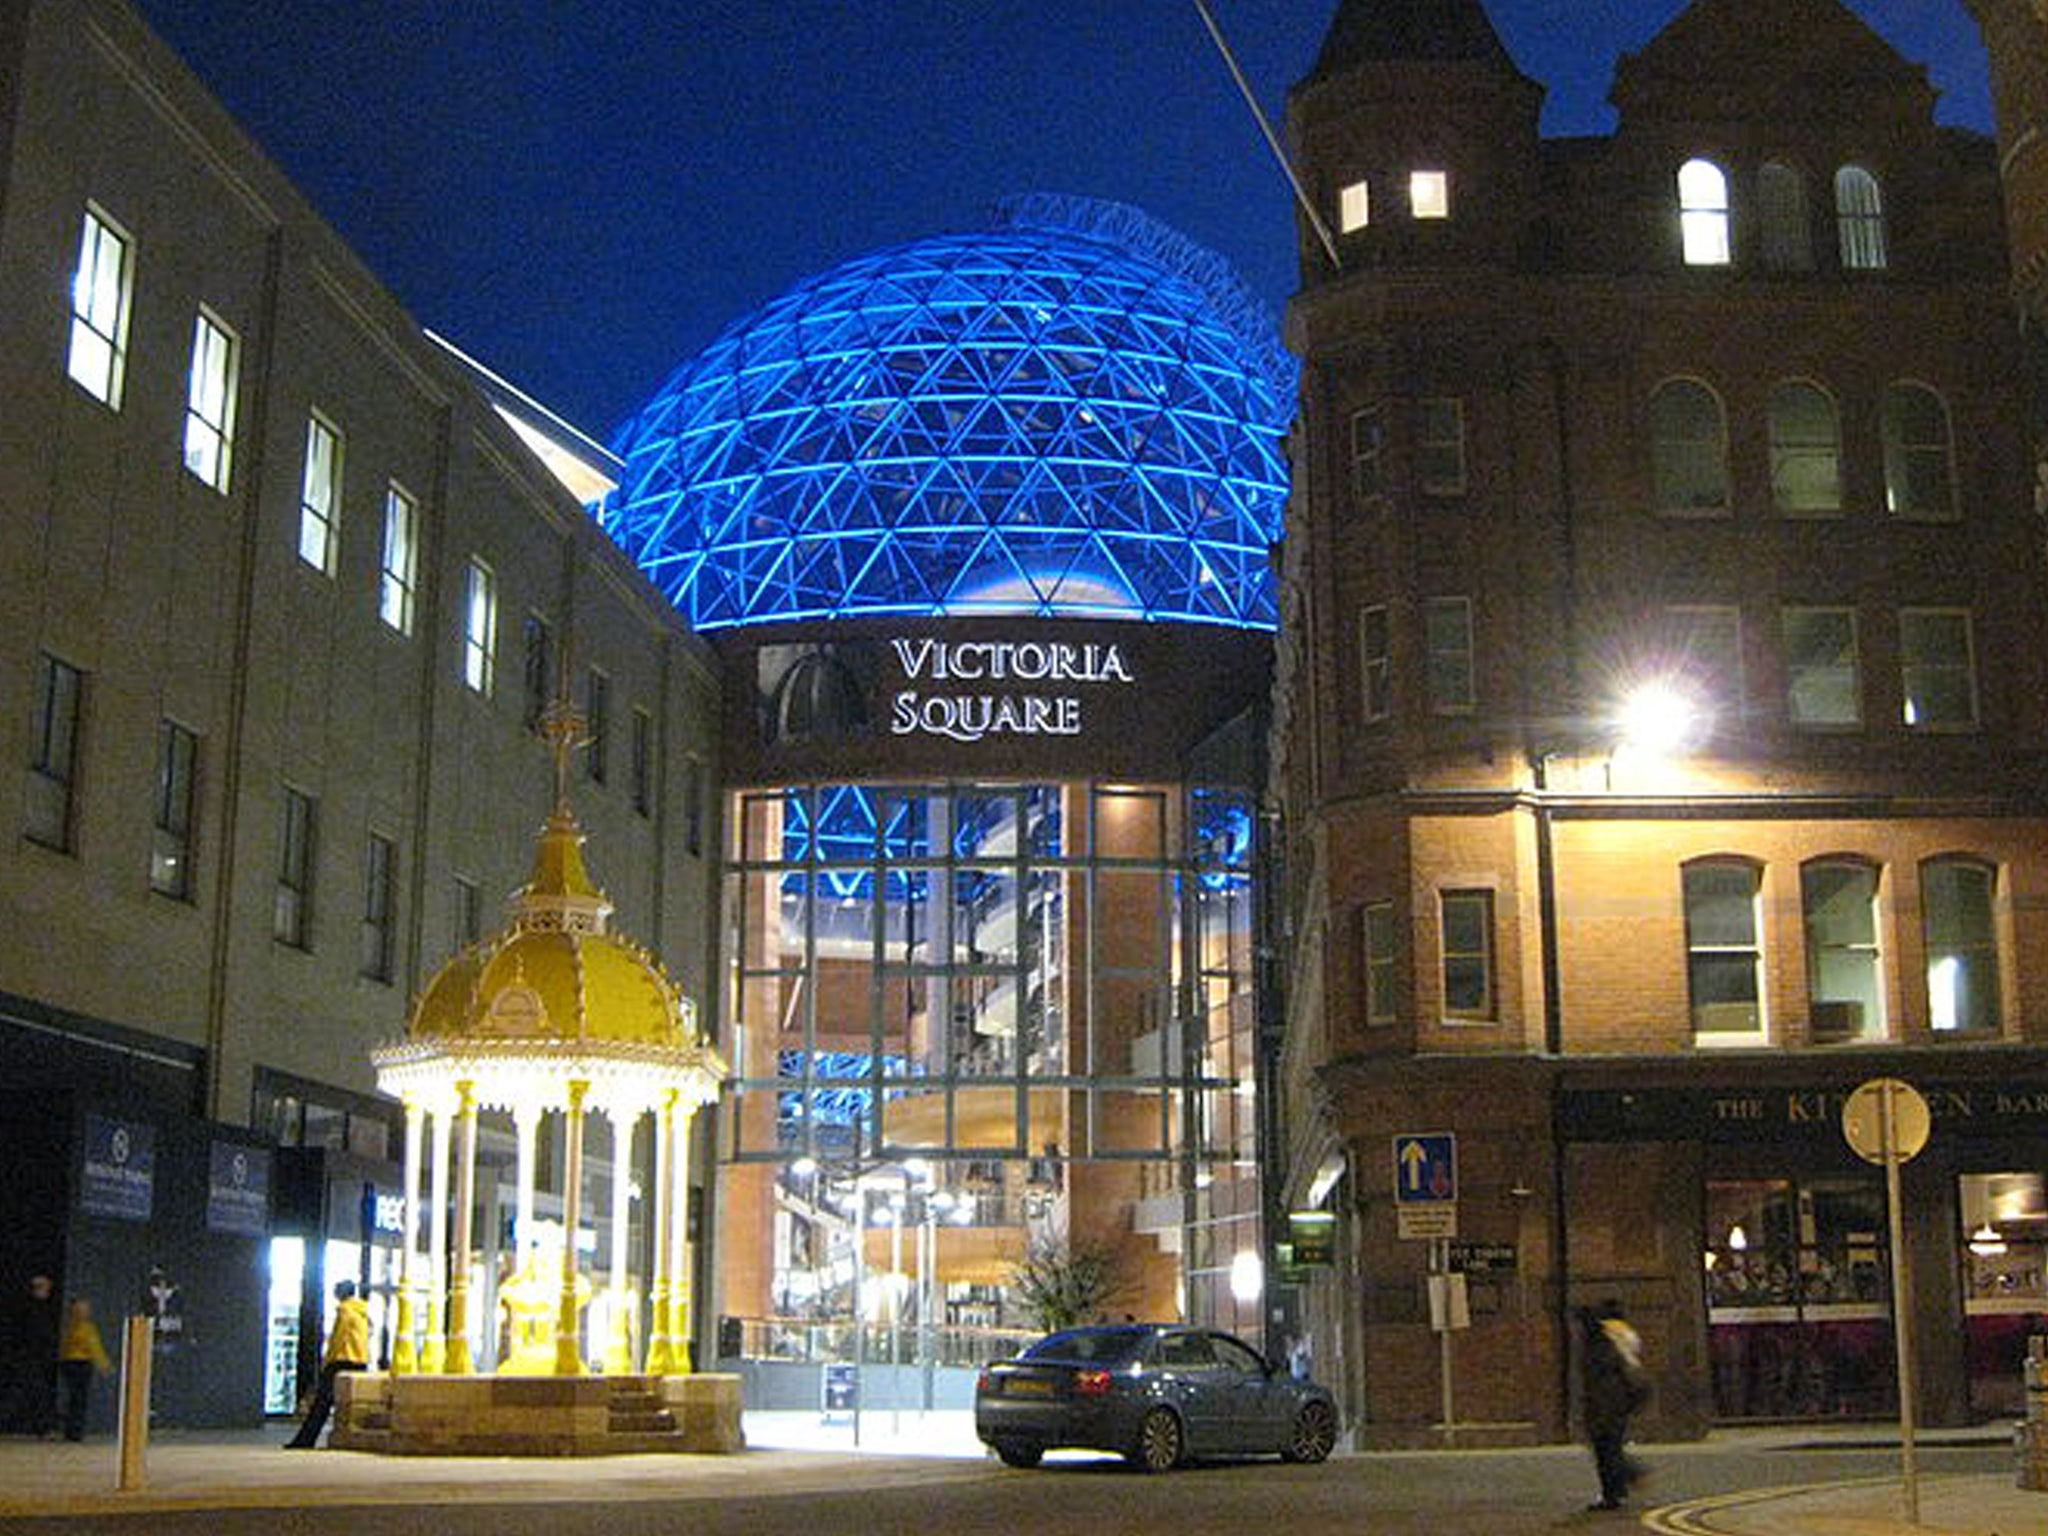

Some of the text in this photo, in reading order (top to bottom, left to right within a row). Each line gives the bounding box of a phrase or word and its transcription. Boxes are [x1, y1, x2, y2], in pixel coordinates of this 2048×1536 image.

[891, 638, 1134, 682] VICTORIA
[891, 691, 1081, 740] SQUARE
[1713, 1097, 1764, 1119] THE
